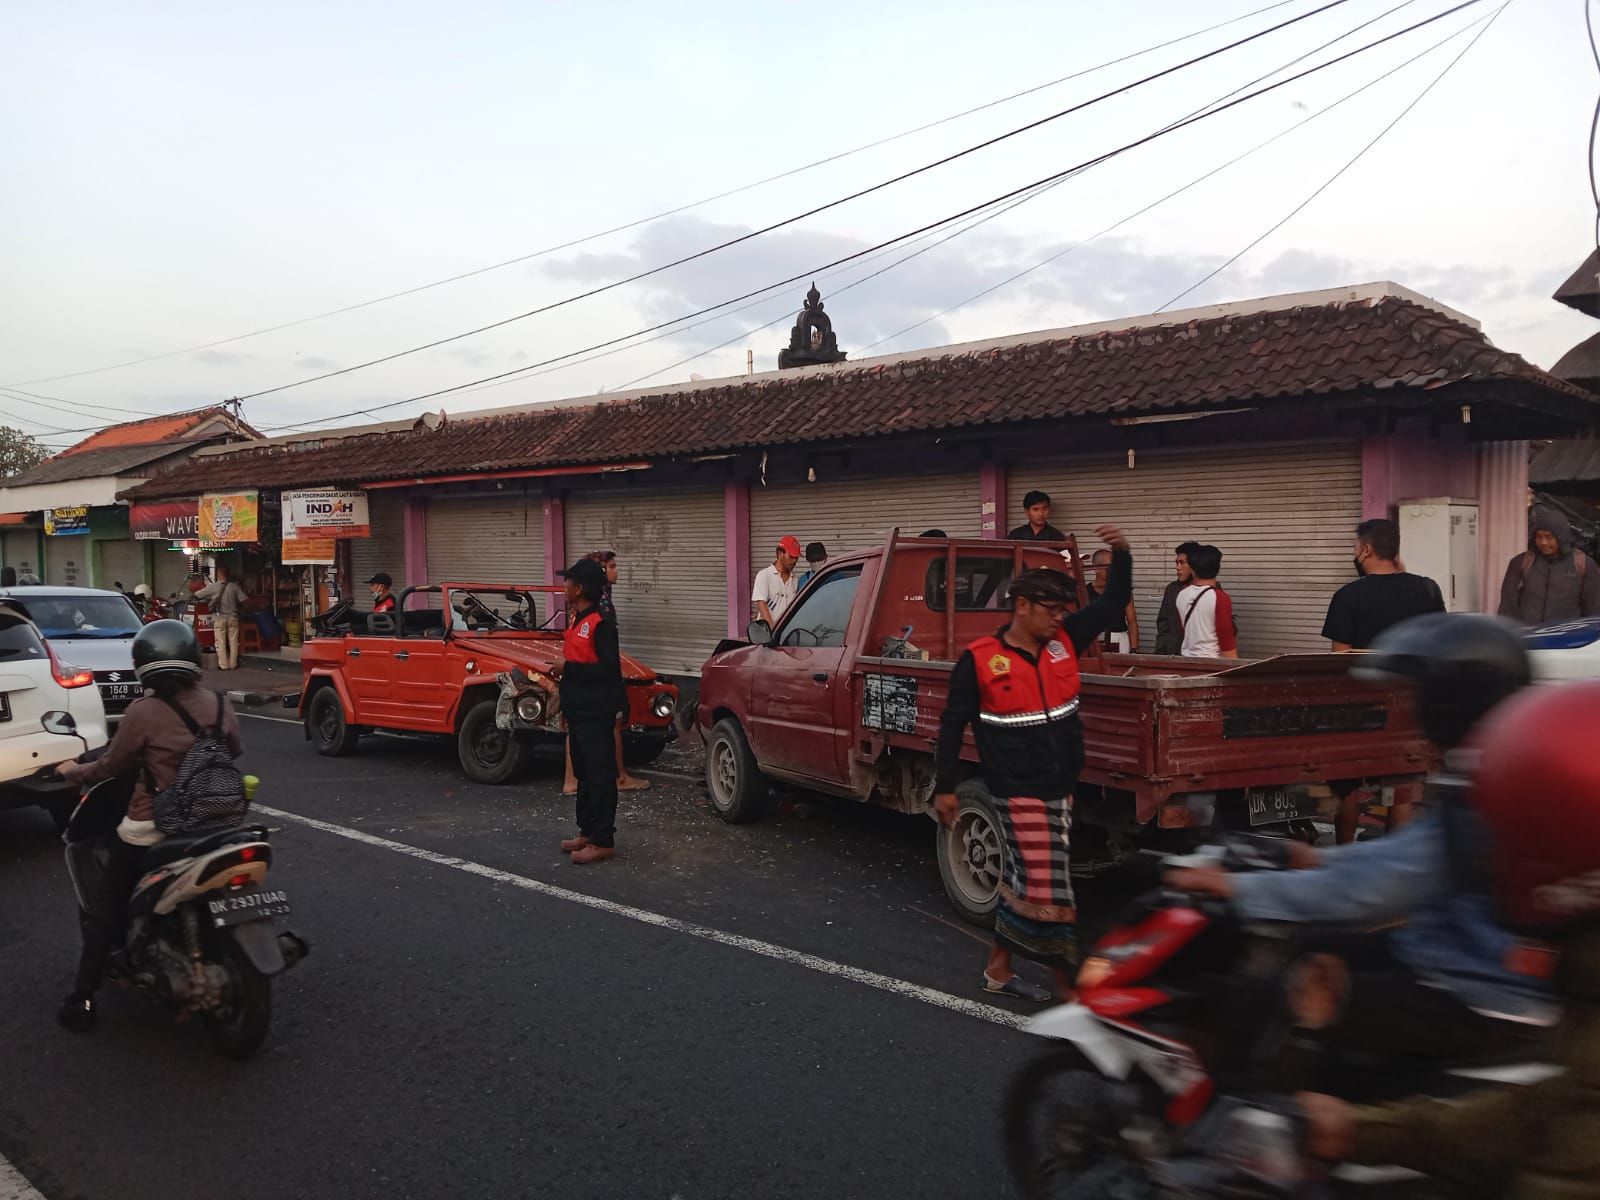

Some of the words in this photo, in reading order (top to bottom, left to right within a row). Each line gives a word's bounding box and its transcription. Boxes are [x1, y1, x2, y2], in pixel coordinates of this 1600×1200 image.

[306, 500, 353, 514] INDAH
[110, 685, 128, 695] 1648
[1253, 792, 1266, 813] DK
[208, 900, 228, 914] DK
